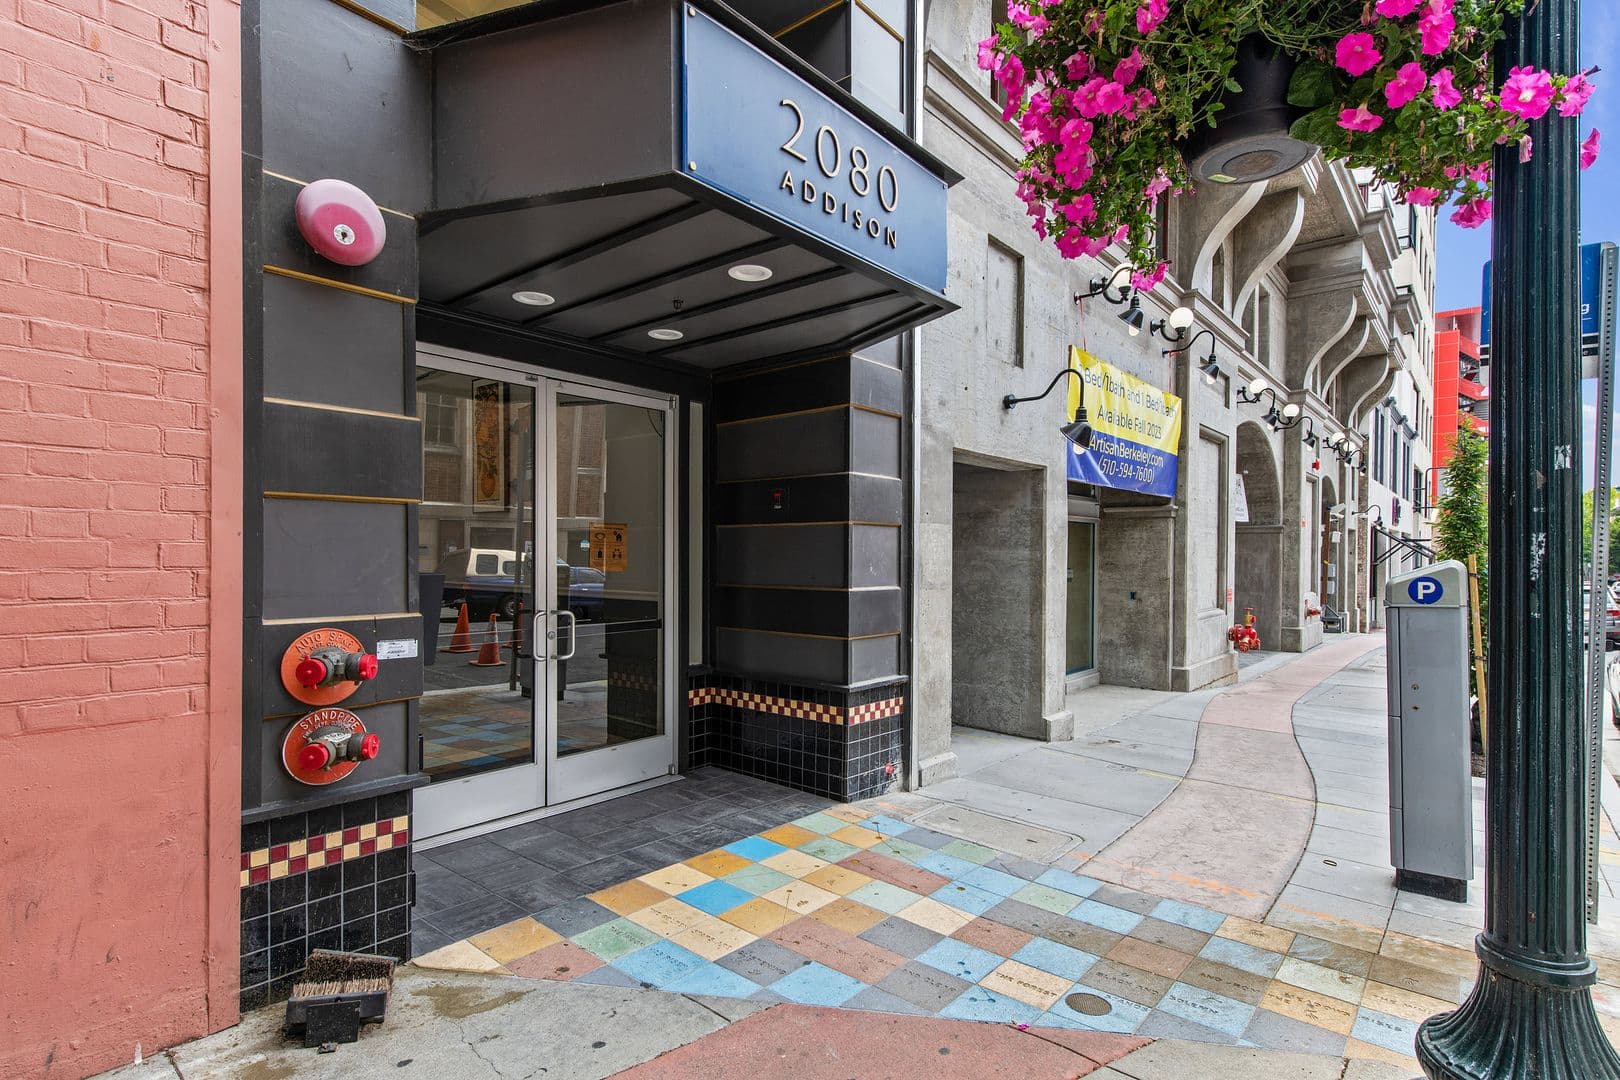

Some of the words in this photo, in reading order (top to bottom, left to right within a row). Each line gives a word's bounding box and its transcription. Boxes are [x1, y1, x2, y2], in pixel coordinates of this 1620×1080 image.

[780, 99, 899, 213] 2080
[780, 170, 897, 249] ADDISON
[1097, 404, 1133, 430] Available
[1134, 417, 1146, 434] Fall
[1147, 421, 1162, 440] 2023
[1089, 434, 1164, 467] ArtisanBerkeley.com
[1098, 454, 1155, 485] (510-594-7600)
[1417, 581, 1436, 600] P
[296, 631, 322, 655] AUTO
[300, 710, 361, 730] STANDPIPE
[1016, 980, 1058, 998] FOREST
[1169, 994, 1218, 1014] SOLEMN
